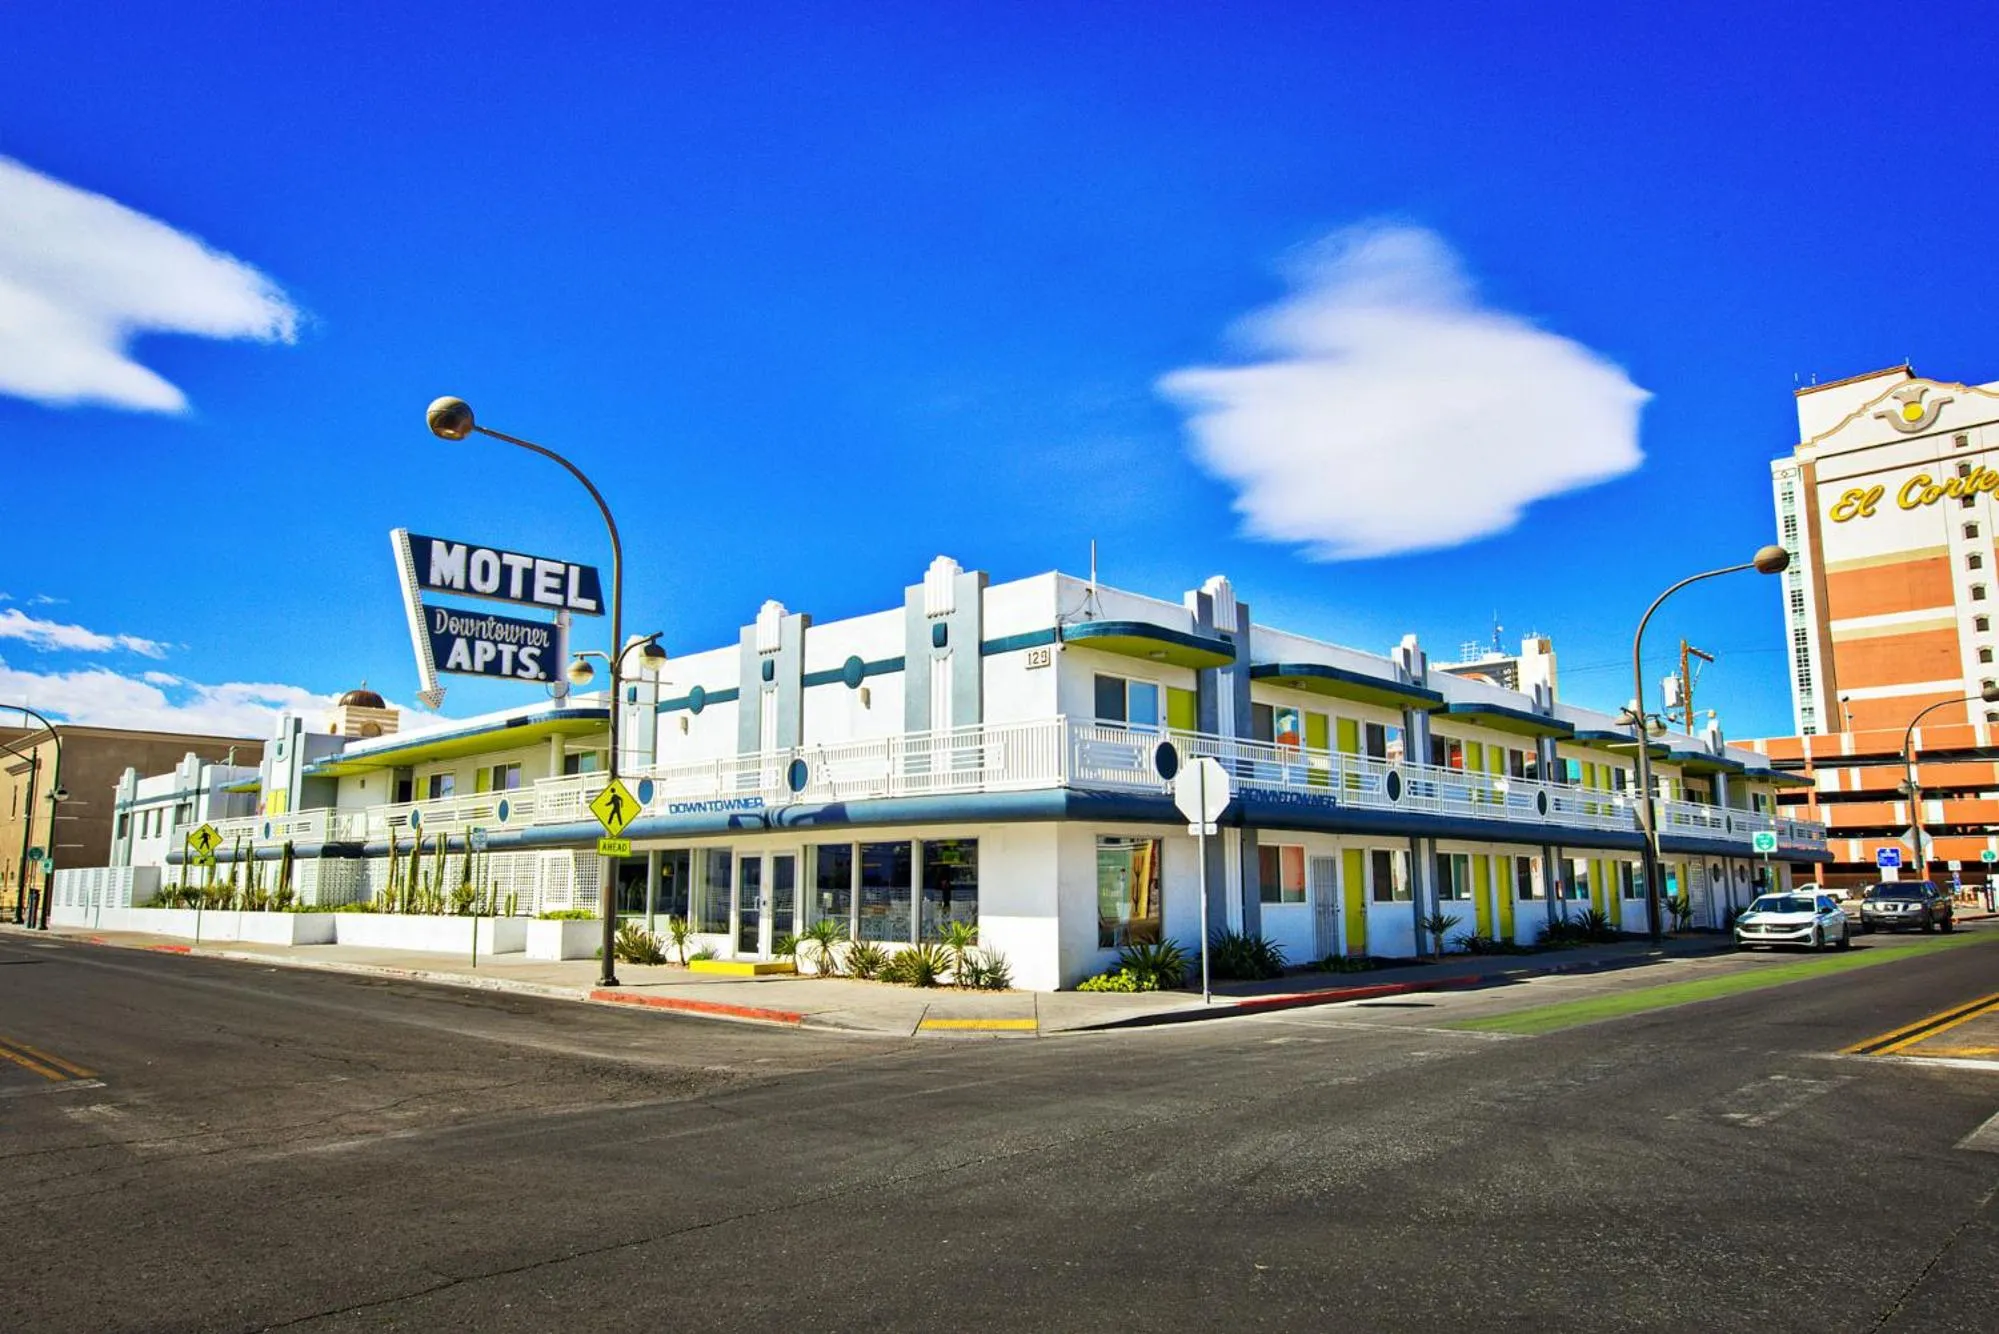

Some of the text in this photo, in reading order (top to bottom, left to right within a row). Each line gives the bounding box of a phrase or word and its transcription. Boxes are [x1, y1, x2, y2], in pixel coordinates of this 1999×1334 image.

[1830, 465, 1999, 523] El Corte
[429, 540, 597, 610] MOTEL
[434, 608, 550, 648] Downtowner
[446, 637, 547, 680] APTS.
[1028, 650, 1047, 665] 129
[668, 796, 765, 814] DOWNTOWNER
[602, 843, 627, 852] AHEAD
